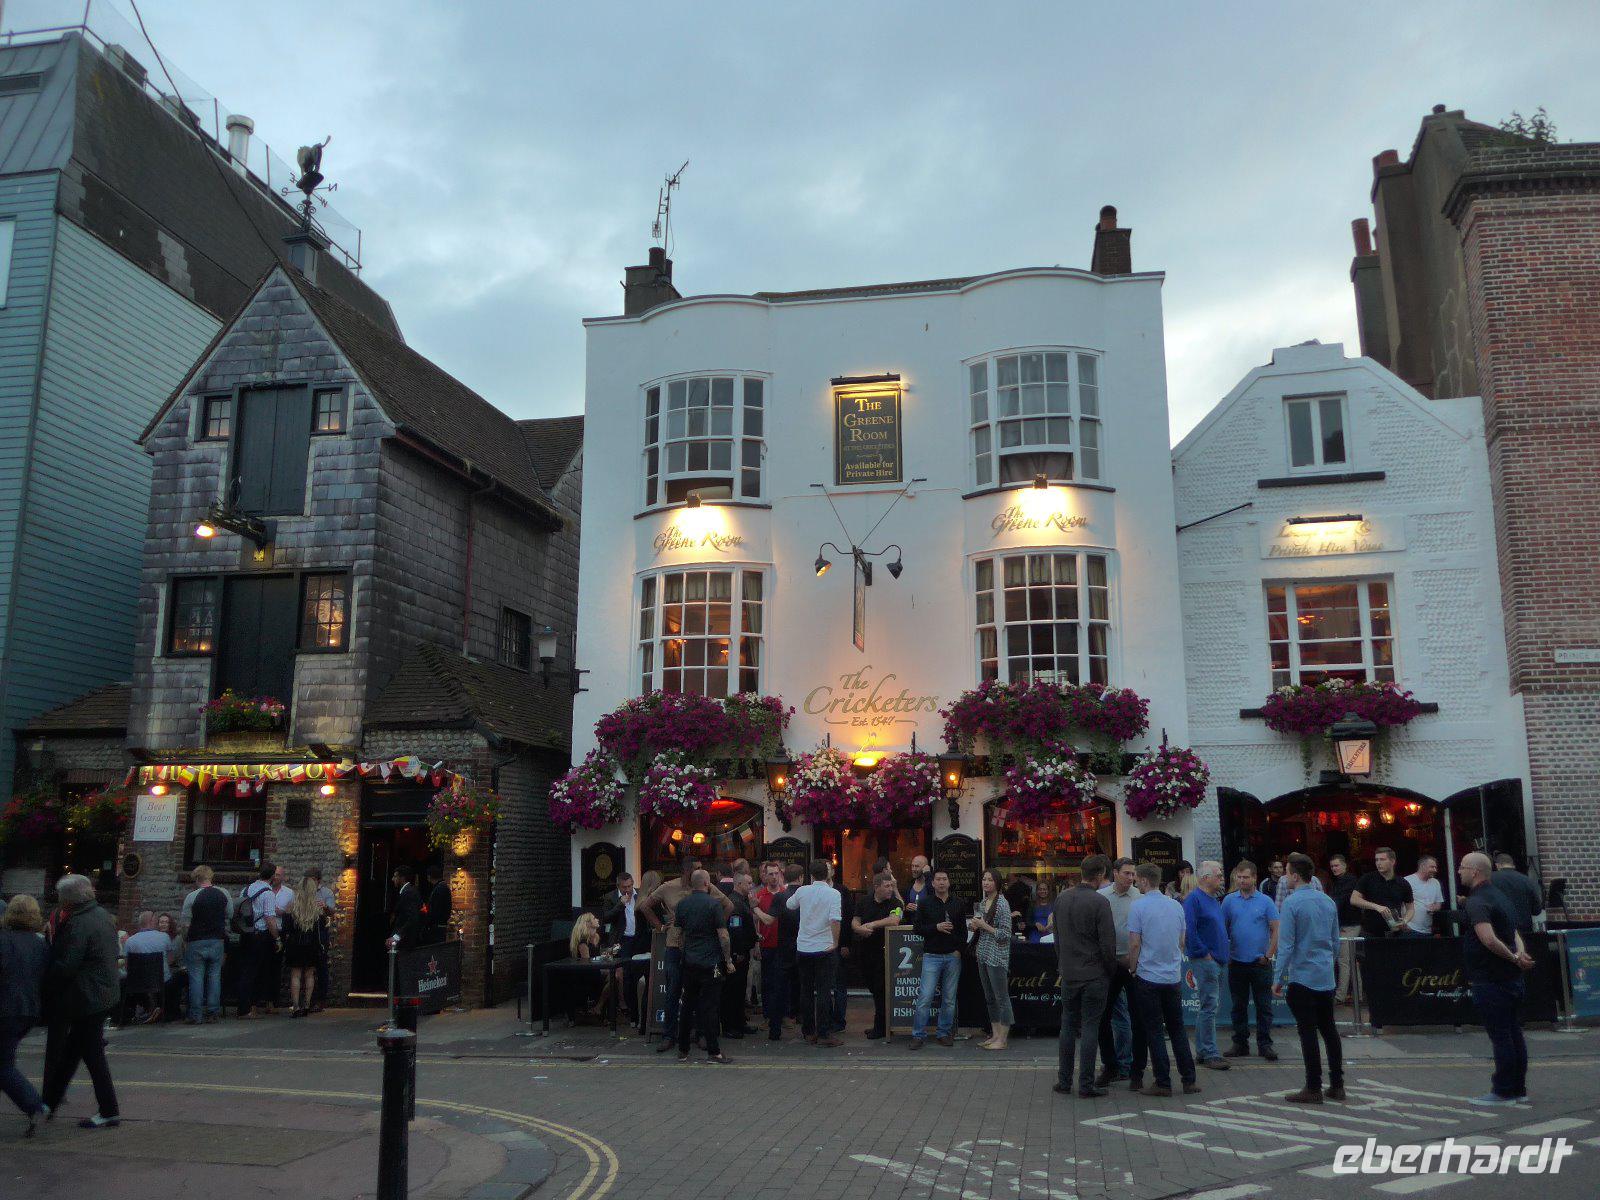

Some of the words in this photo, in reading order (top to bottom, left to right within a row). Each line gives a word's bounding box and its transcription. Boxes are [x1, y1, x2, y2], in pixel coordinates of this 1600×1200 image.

[845, 461, 881, 470] Available
[882, 460, 894, 468] for
[846, 470, 875, 478] Private
[876, 469, 894, 477] Hire
[991, 513, 1040, 538] Greene
[1045, 512, 1088, 533] Room
[700, 530, 745, 553] Room
[1268, 544, 1312, 557] Private
[1318, 540, 1347, 554] Hire
[840, 665, 873, 690] The
[803, 673, 940, 714] Cricketers
[147, 801, 166, 812] Beer
[140, 812, 171, 823] Garden
[149, 823, 169, 834] Rear
[897, 946, 913, 969] 2
[418, 976, 448, 993] Heineken
[1008, 970, 1049, 988] reat
[1401, 967, 1462, 999] Great
